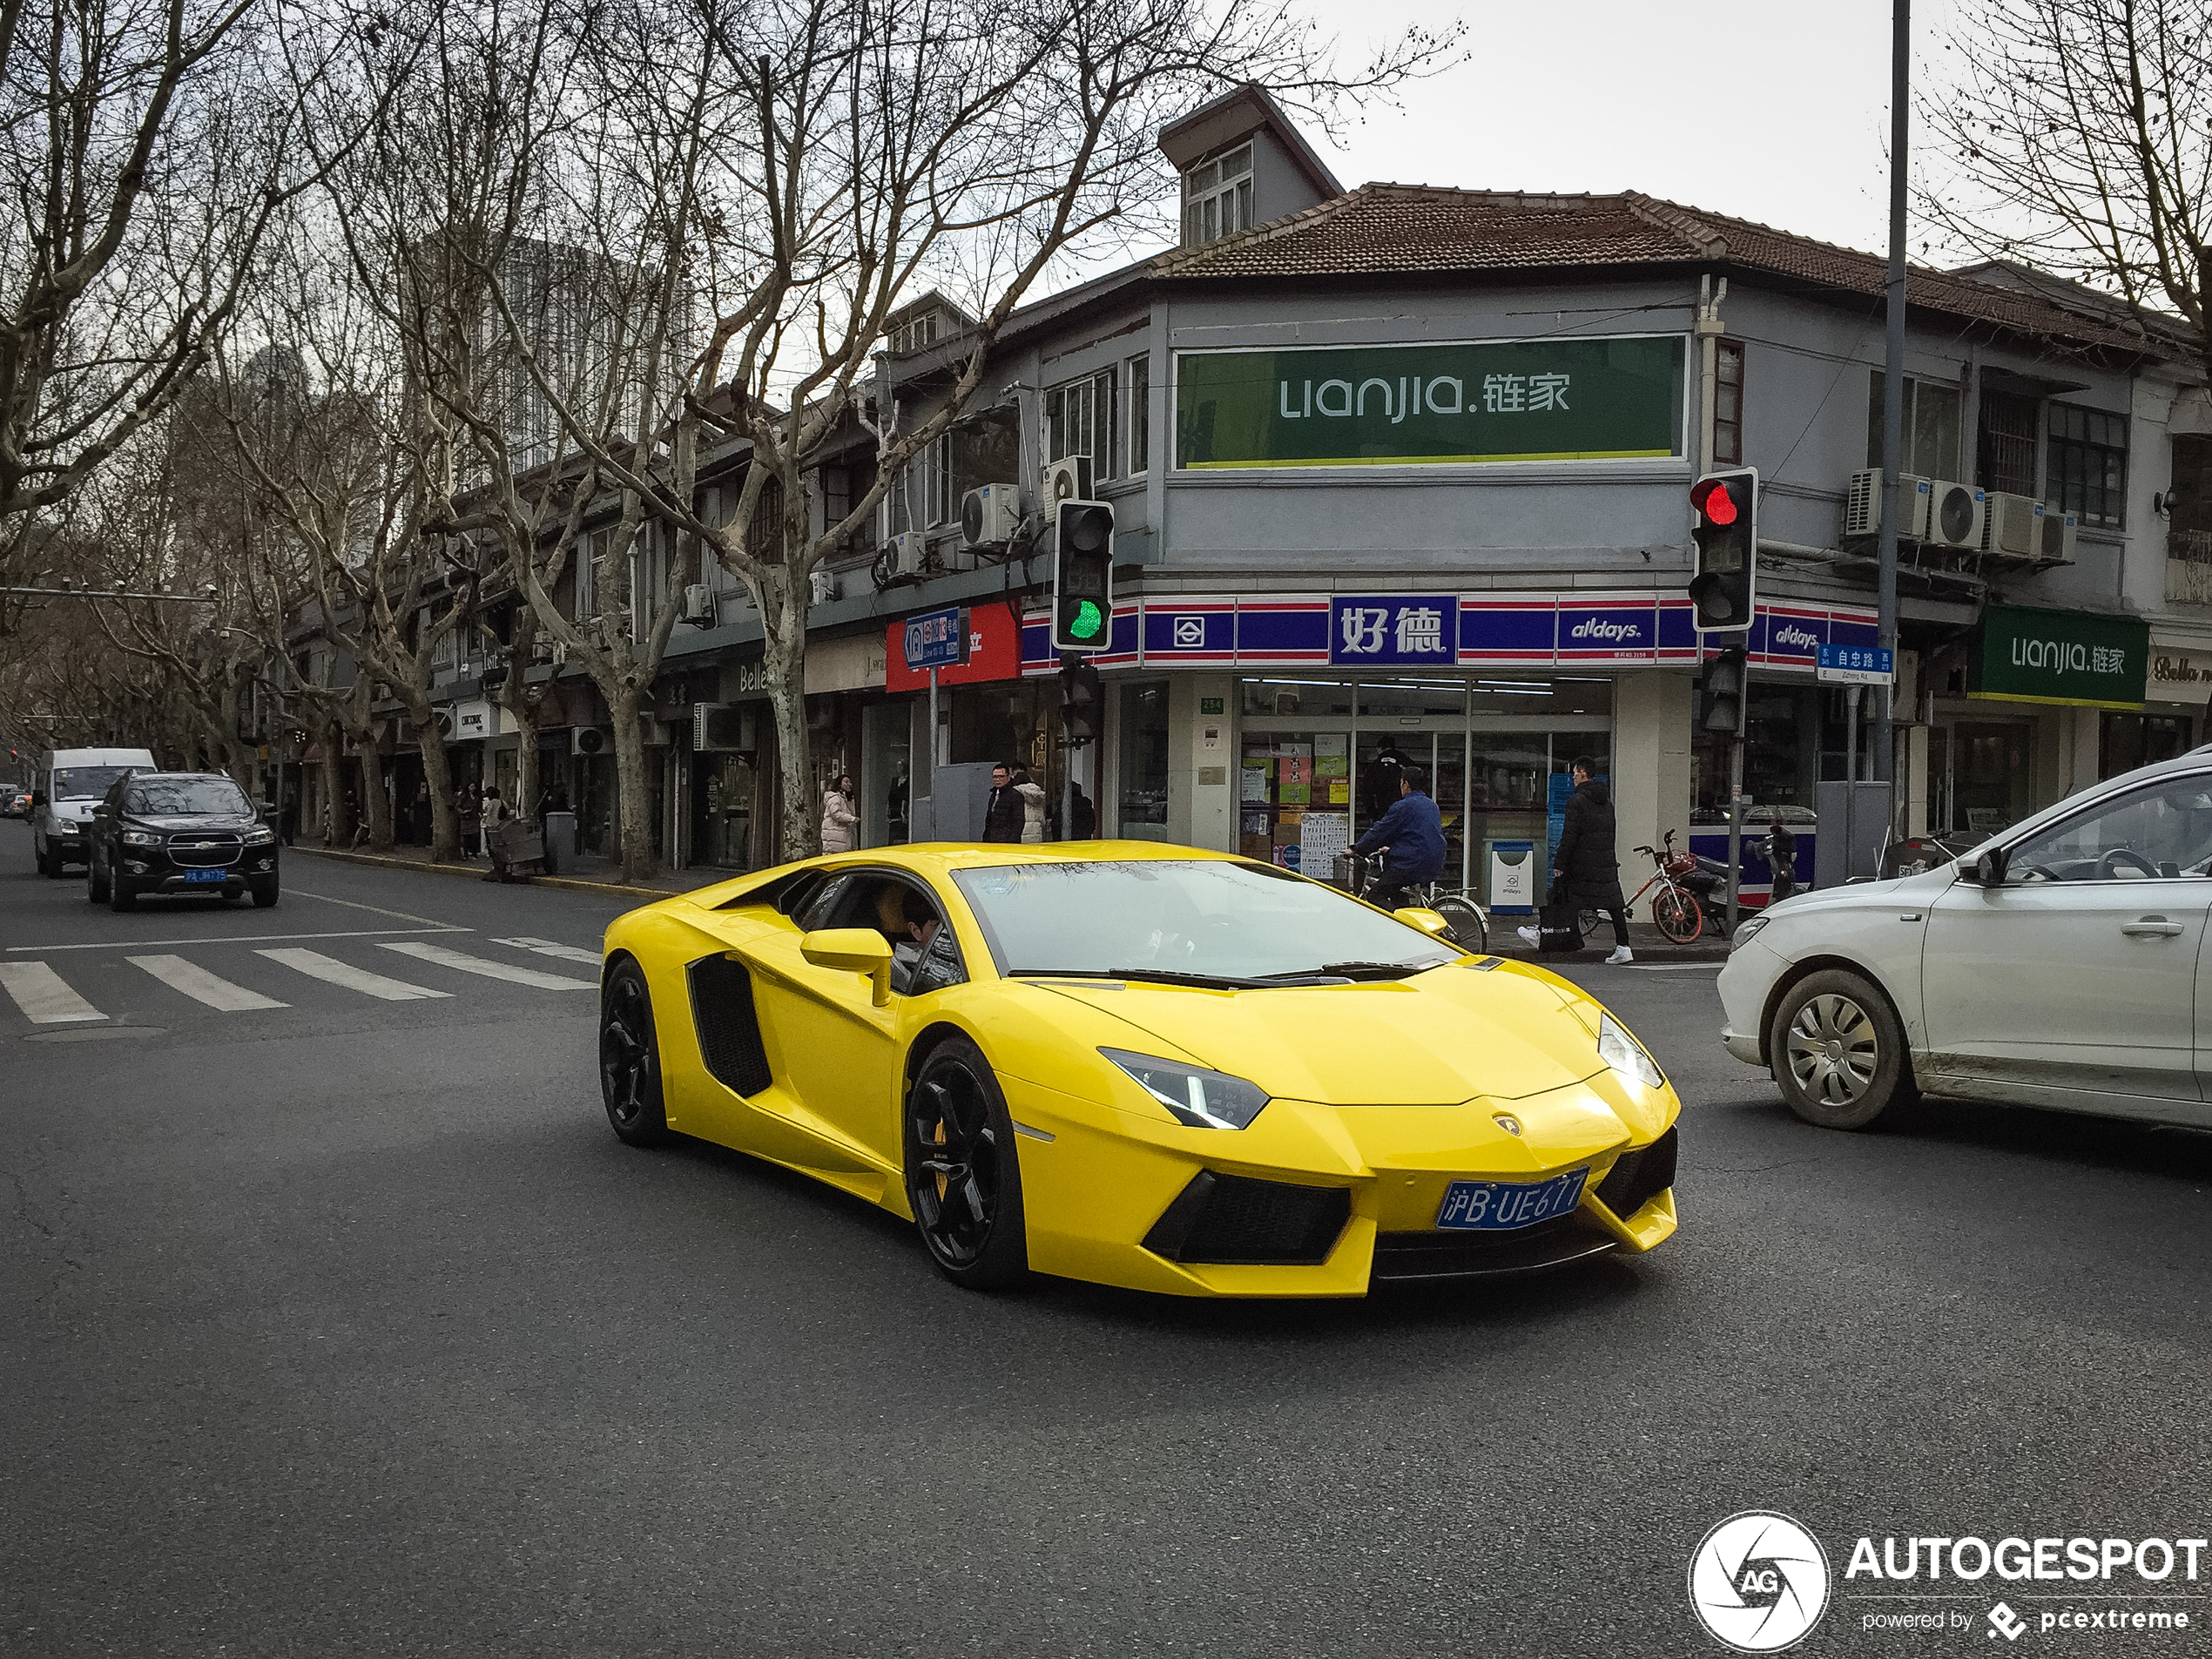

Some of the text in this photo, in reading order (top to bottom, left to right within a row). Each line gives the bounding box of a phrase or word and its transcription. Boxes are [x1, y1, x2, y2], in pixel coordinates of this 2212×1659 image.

[1482, 373, 1570, 413] 链家
[1340, 606, 1442, 654] 好德
[1822, 670, 1828, 678] E
[1838, 650, 1873, 668] 自忠路
[2092, 645, 2125, 675] 链家
